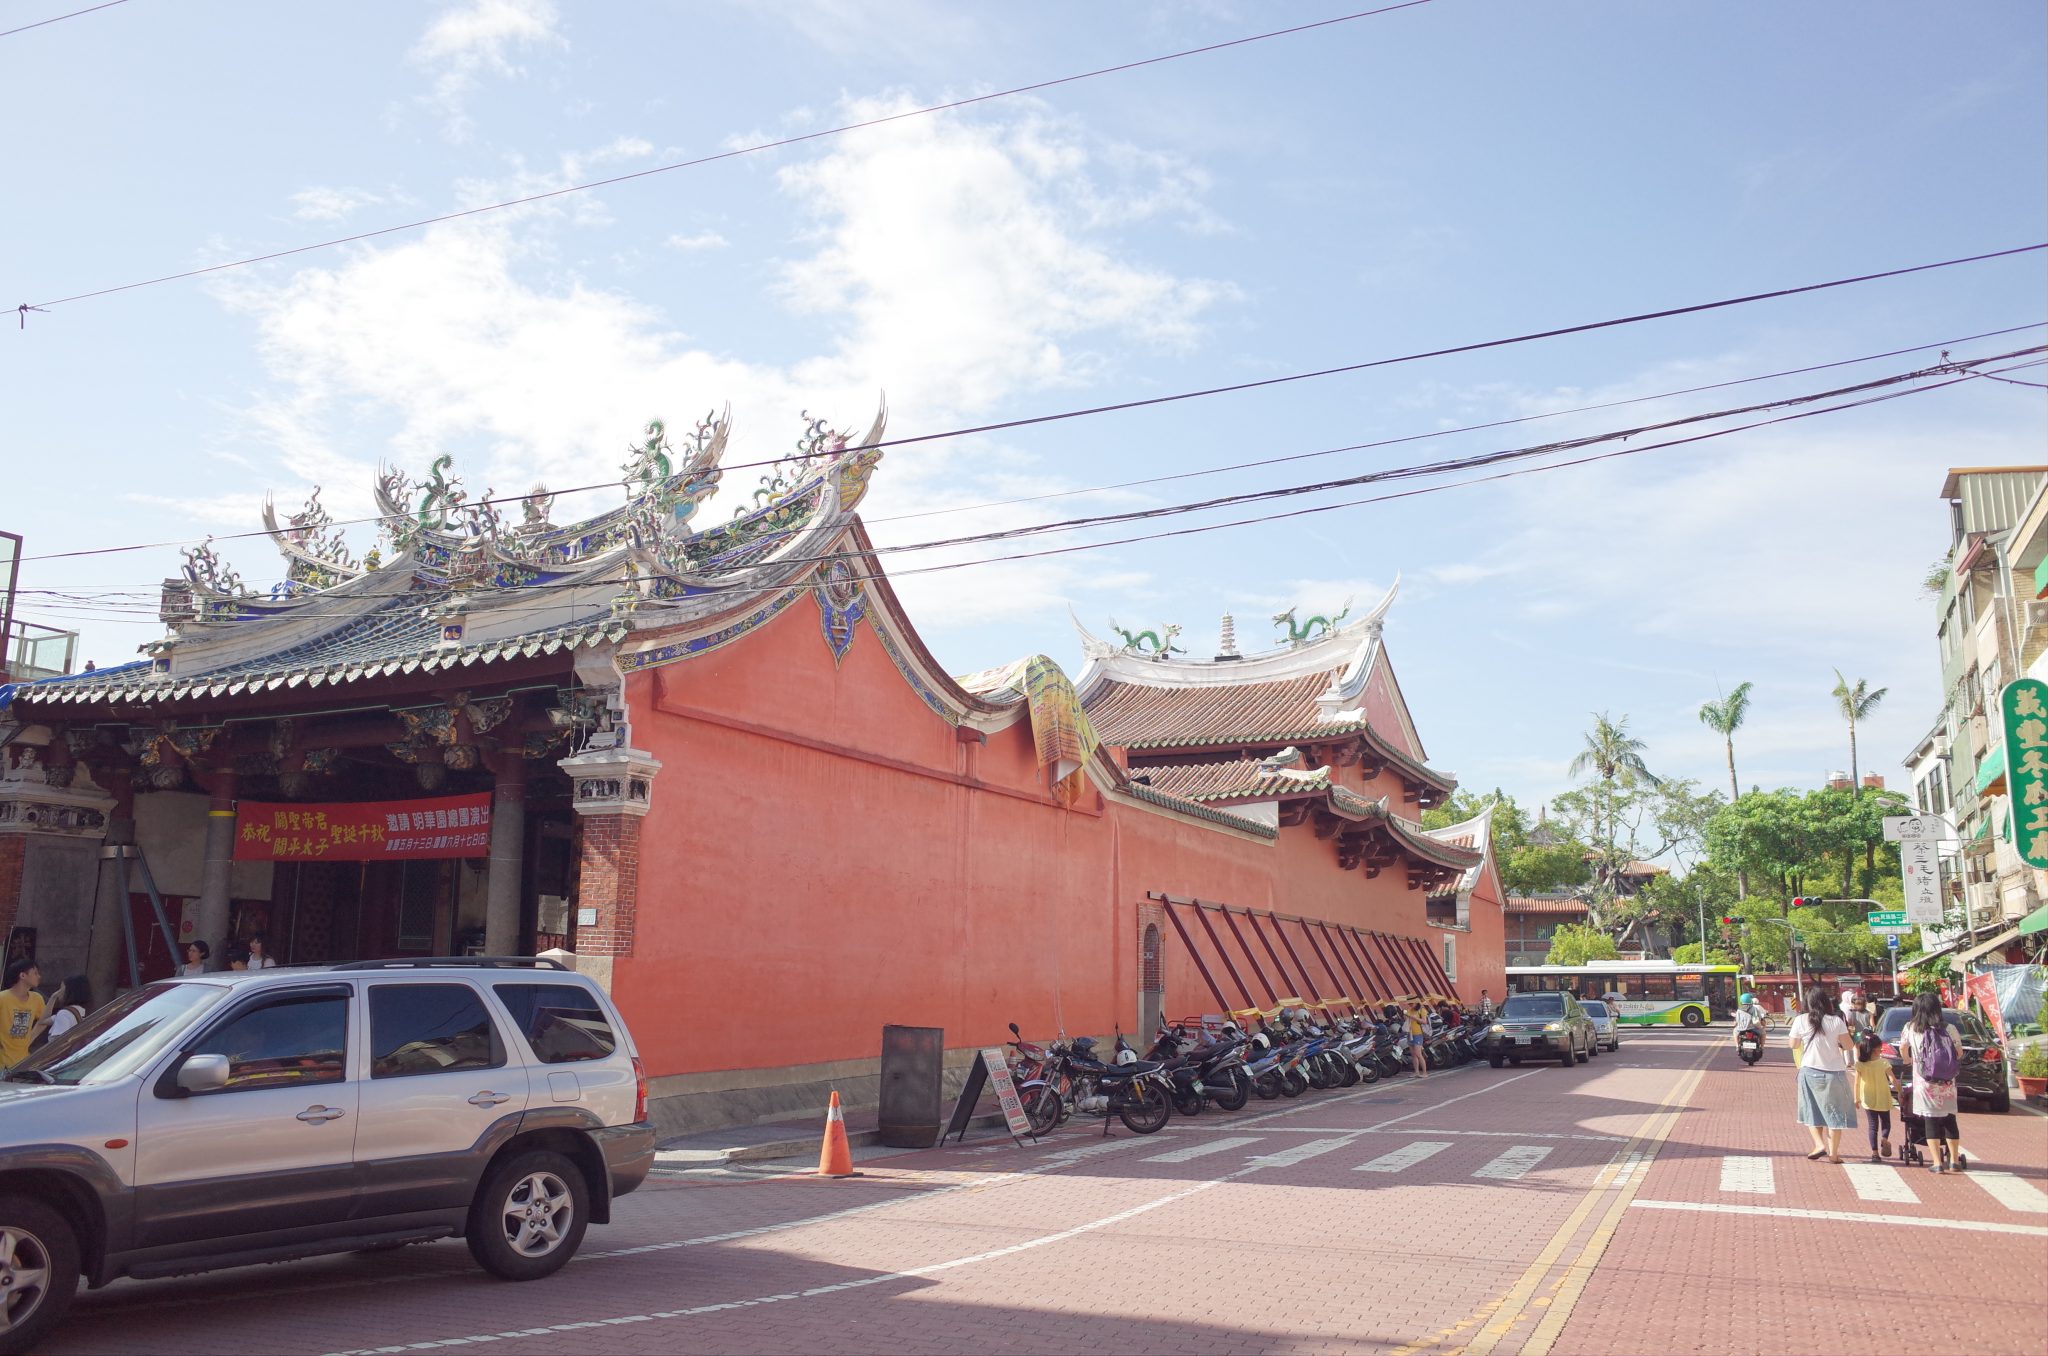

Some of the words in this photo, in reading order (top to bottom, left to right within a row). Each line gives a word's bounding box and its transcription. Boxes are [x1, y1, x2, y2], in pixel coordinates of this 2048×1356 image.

[273, 811, 328, 831] 關聖帝君
[385, 813, 410, 832] 邀請
[412, 805, 490, 831] 明華園總團演出
[240, 822, 272, 843] 恭祝
[330, 823, 385, 844] 聖誕千秋
[272, 837, 329, 856] 關平太子
